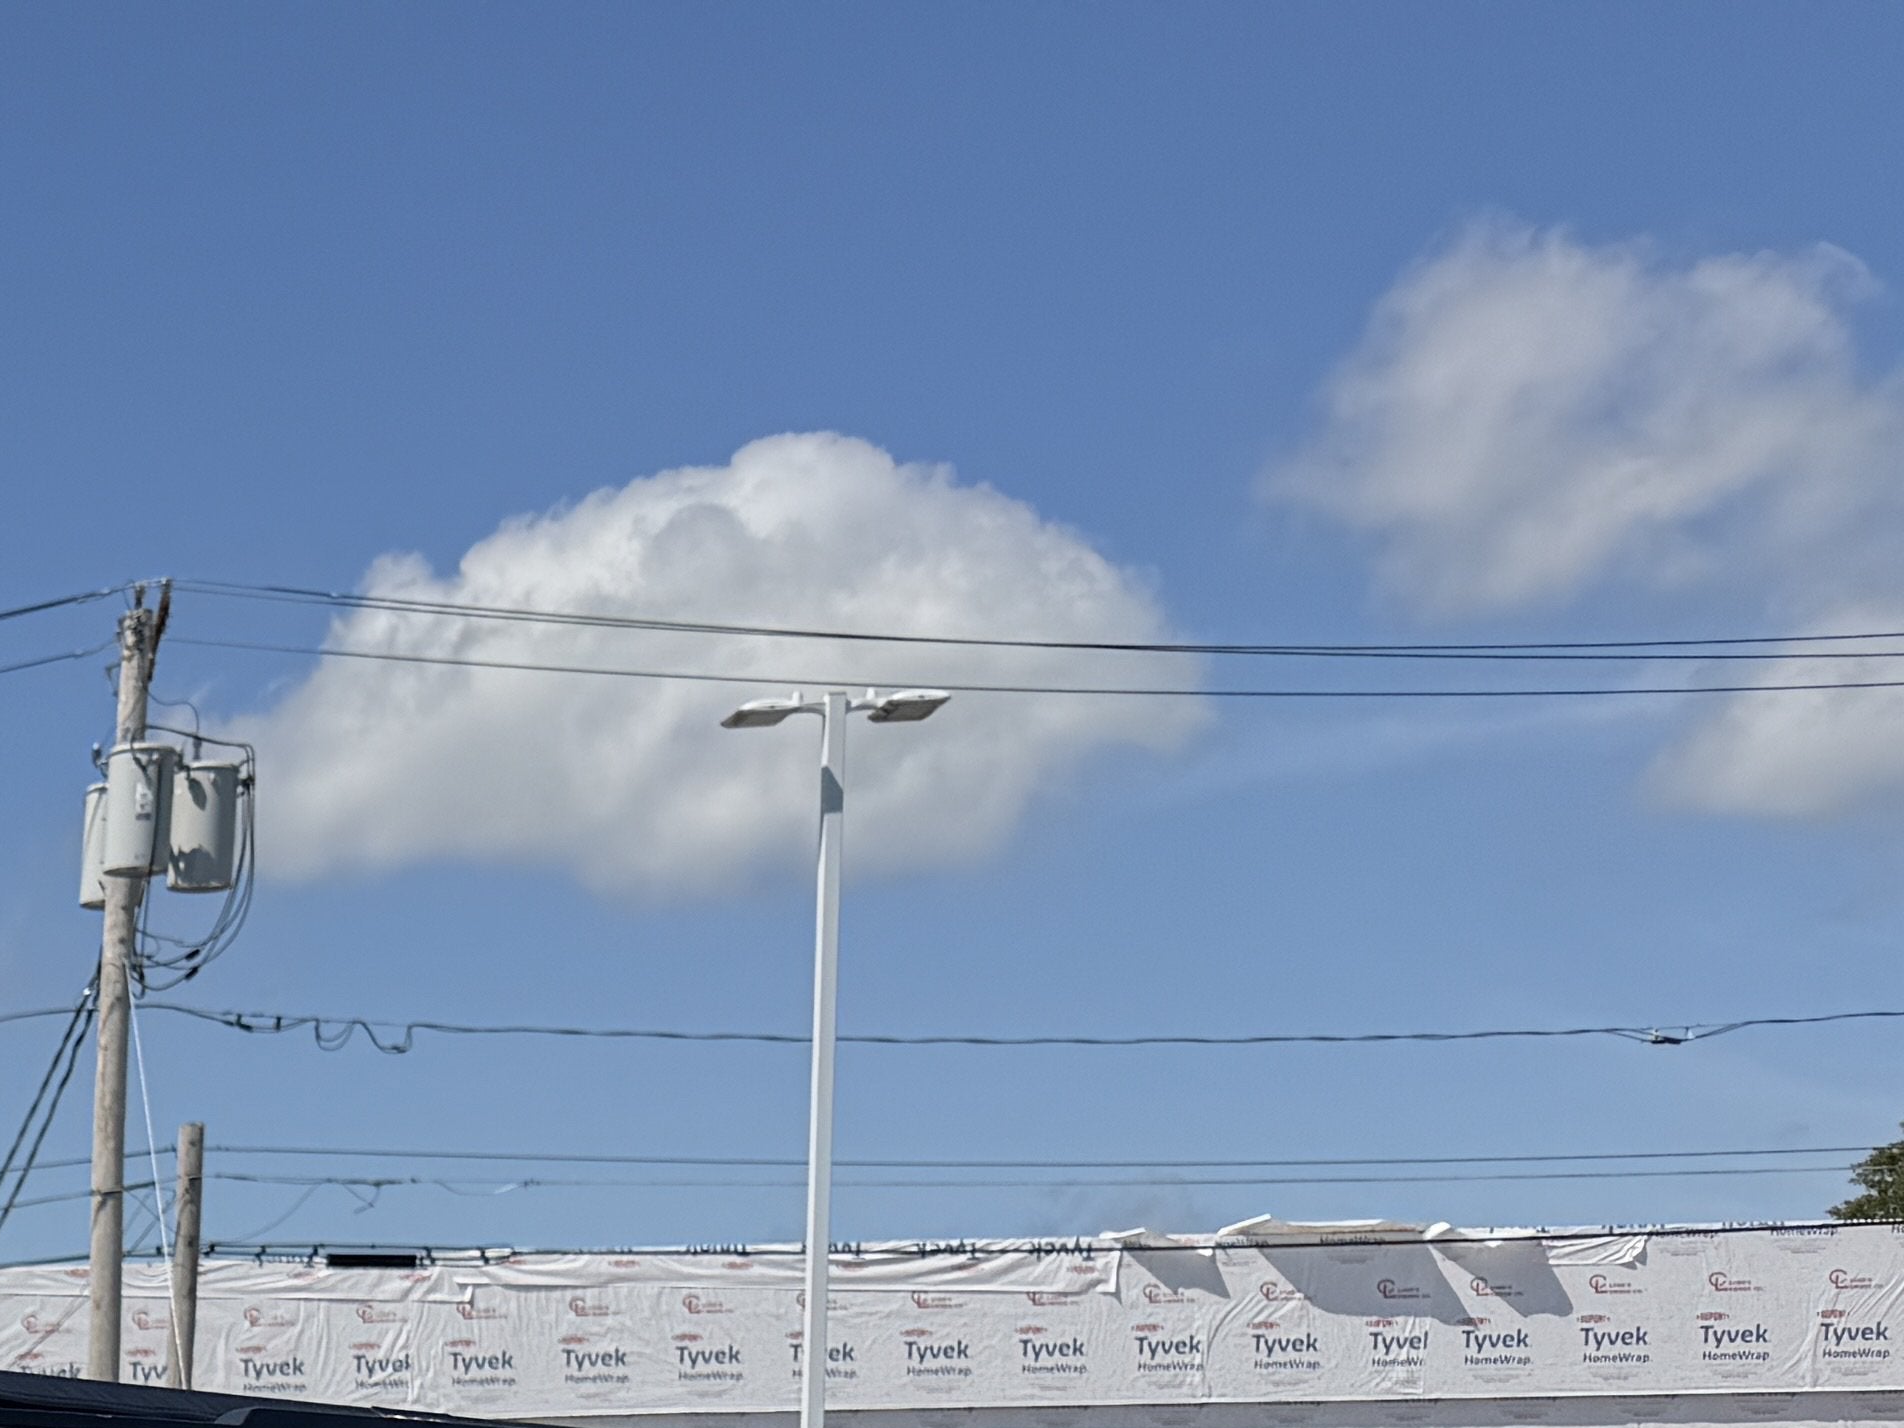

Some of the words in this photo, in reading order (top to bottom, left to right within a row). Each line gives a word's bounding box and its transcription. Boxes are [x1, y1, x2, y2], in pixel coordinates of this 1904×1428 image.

[1252, 1332, 1319, 1357] Tyvek
[1462, 1327, 1529, 1353] Tyvek
[1580, 1326, 1648, 1350] Tyvek
[1700, 1324, 1768, 1348] Tyvek
[1821, 1321, 1889, 1346] Tyvek
[676, 1345, 741, 1368] Tyvek
[789, 1342, 855, 1362] Tek
[904, 1340, 969, 1363] Tyvek
[1019, 1338, 1084, 1362] Tyvek
[1135, 1335, 1201, 1358] Tyvek
[242, 1358, 305, 1381] Tyvek
[450, 1351, 513, 1374] Tyvek
[562, 1347, 627, 1371] Tyvek
[129, 1361, 168, 1383] Tyv
